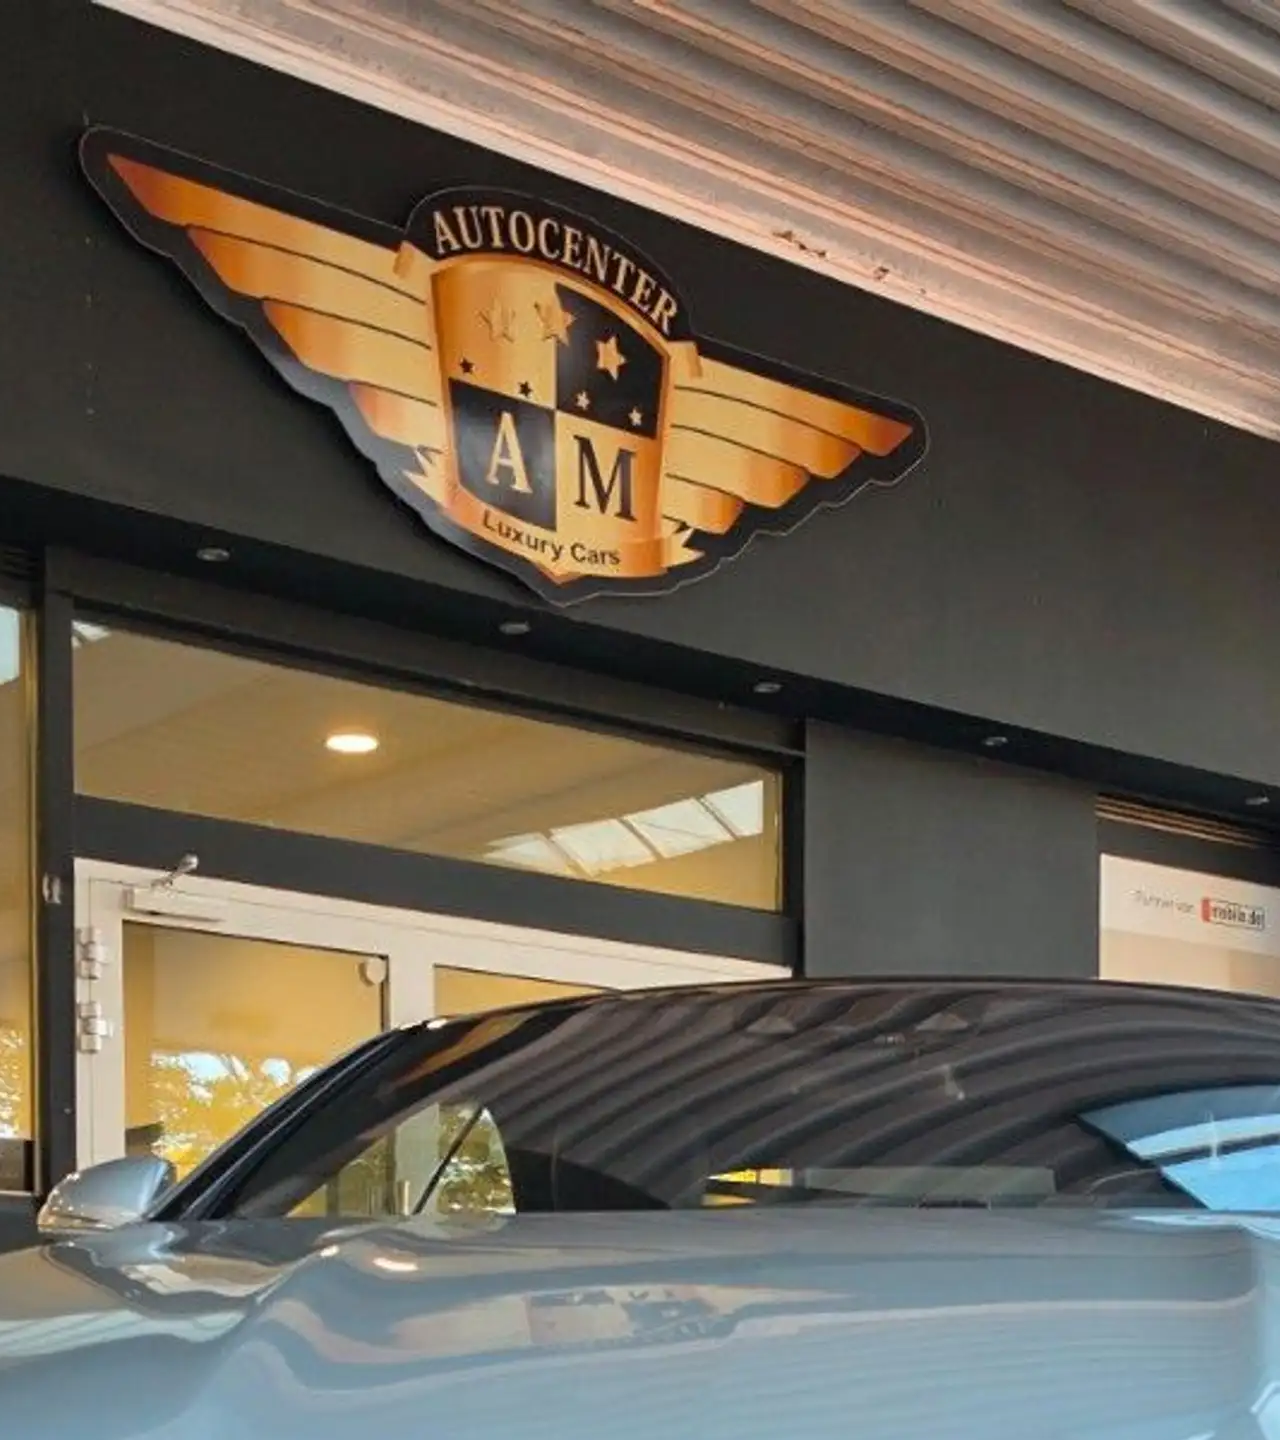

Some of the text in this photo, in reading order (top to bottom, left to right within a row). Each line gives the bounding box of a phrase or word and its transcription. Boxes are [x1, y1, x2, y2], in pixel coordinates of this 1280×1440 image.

[433, 206, 678, 335] AUTOCENTER
[485, 411, 637, 522] A M
[482, 509, 621, 565] Luxury Cars
